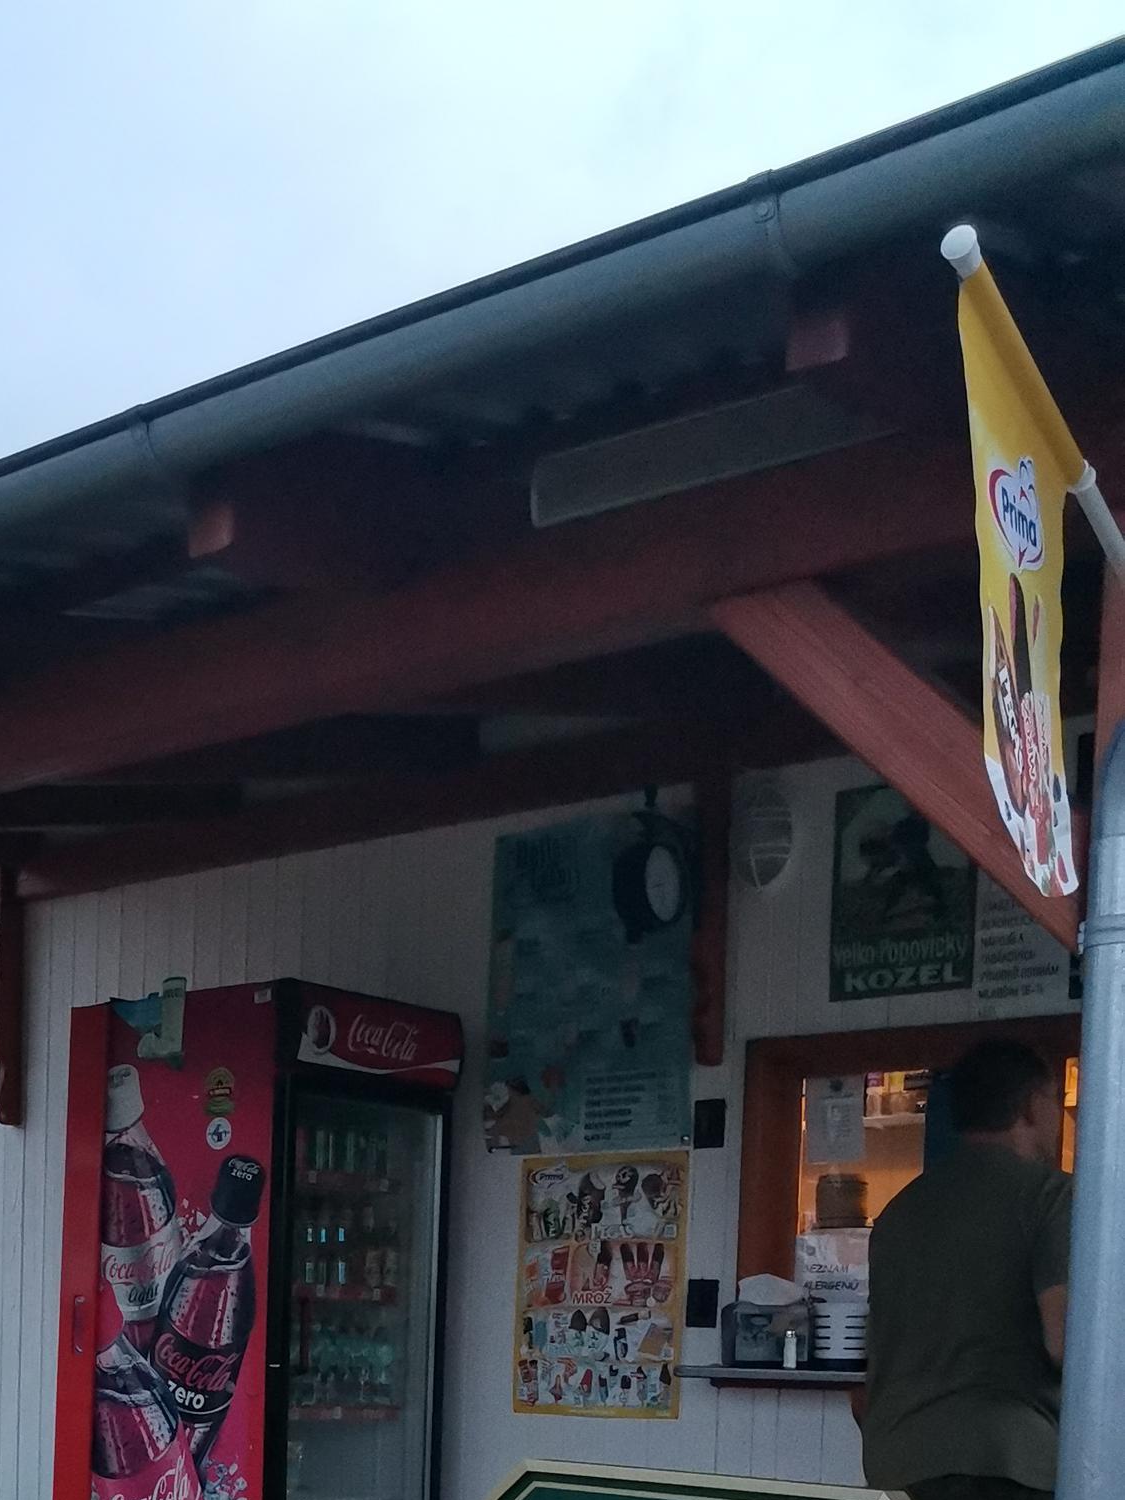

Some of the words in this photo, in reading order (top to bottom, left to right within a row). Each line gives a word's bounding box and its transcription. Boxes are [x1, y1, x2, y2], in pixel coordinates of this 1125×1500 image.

[1002, 486, 1037, 547] Prima
[844, 961, 965, 993] KOZEL
[230, 1168, 254, 1181] zero
